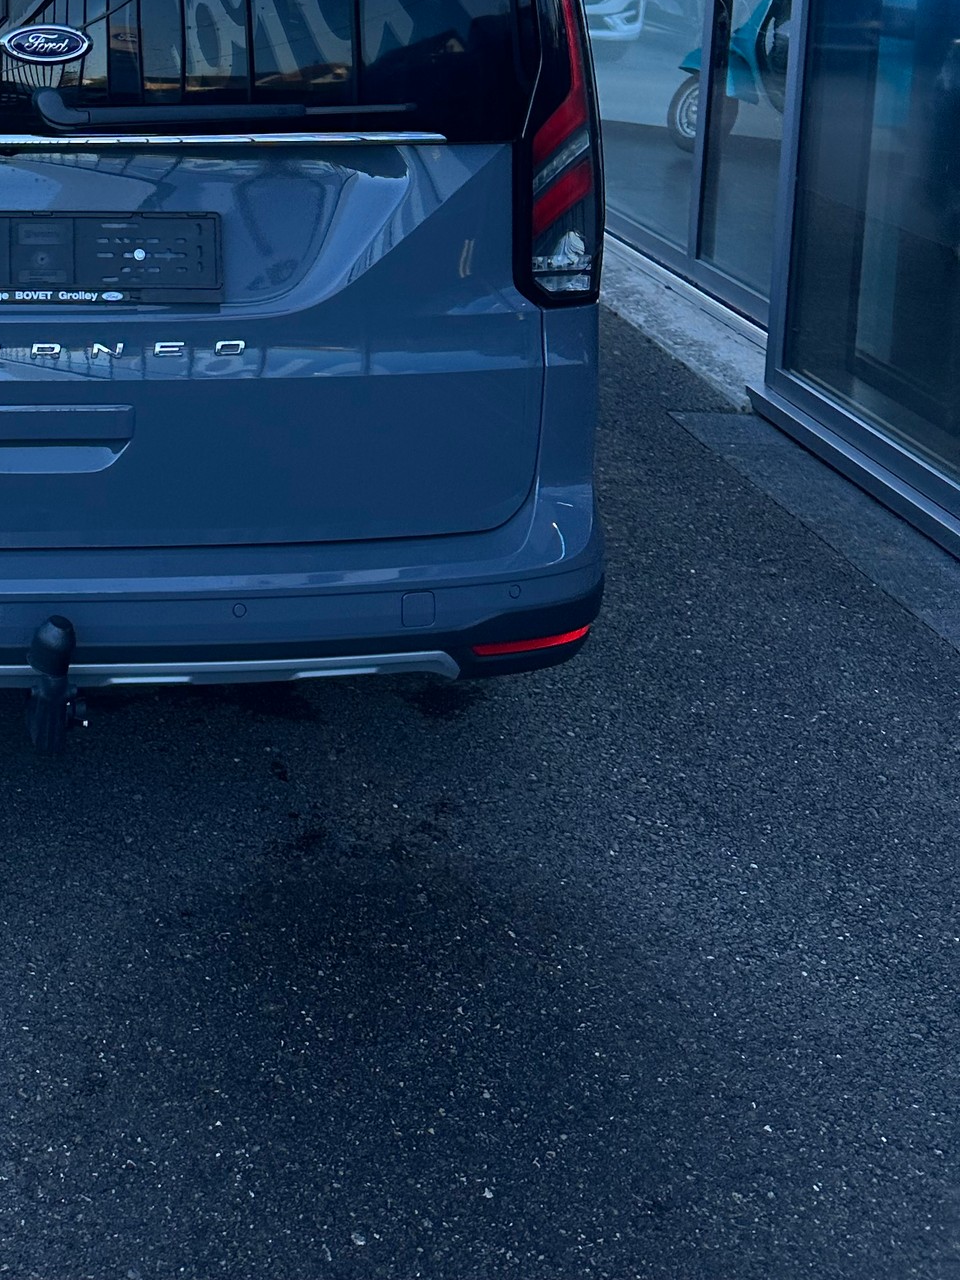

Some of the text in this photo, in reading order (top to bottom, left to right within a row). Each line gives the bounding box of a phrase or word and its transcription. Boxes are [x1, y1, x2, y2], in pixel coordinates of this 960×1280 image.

[23, 33, 70, 53] Ford
[15, 291, 53, 300] BOVET
[58, 291, 98, 301] Grolley
